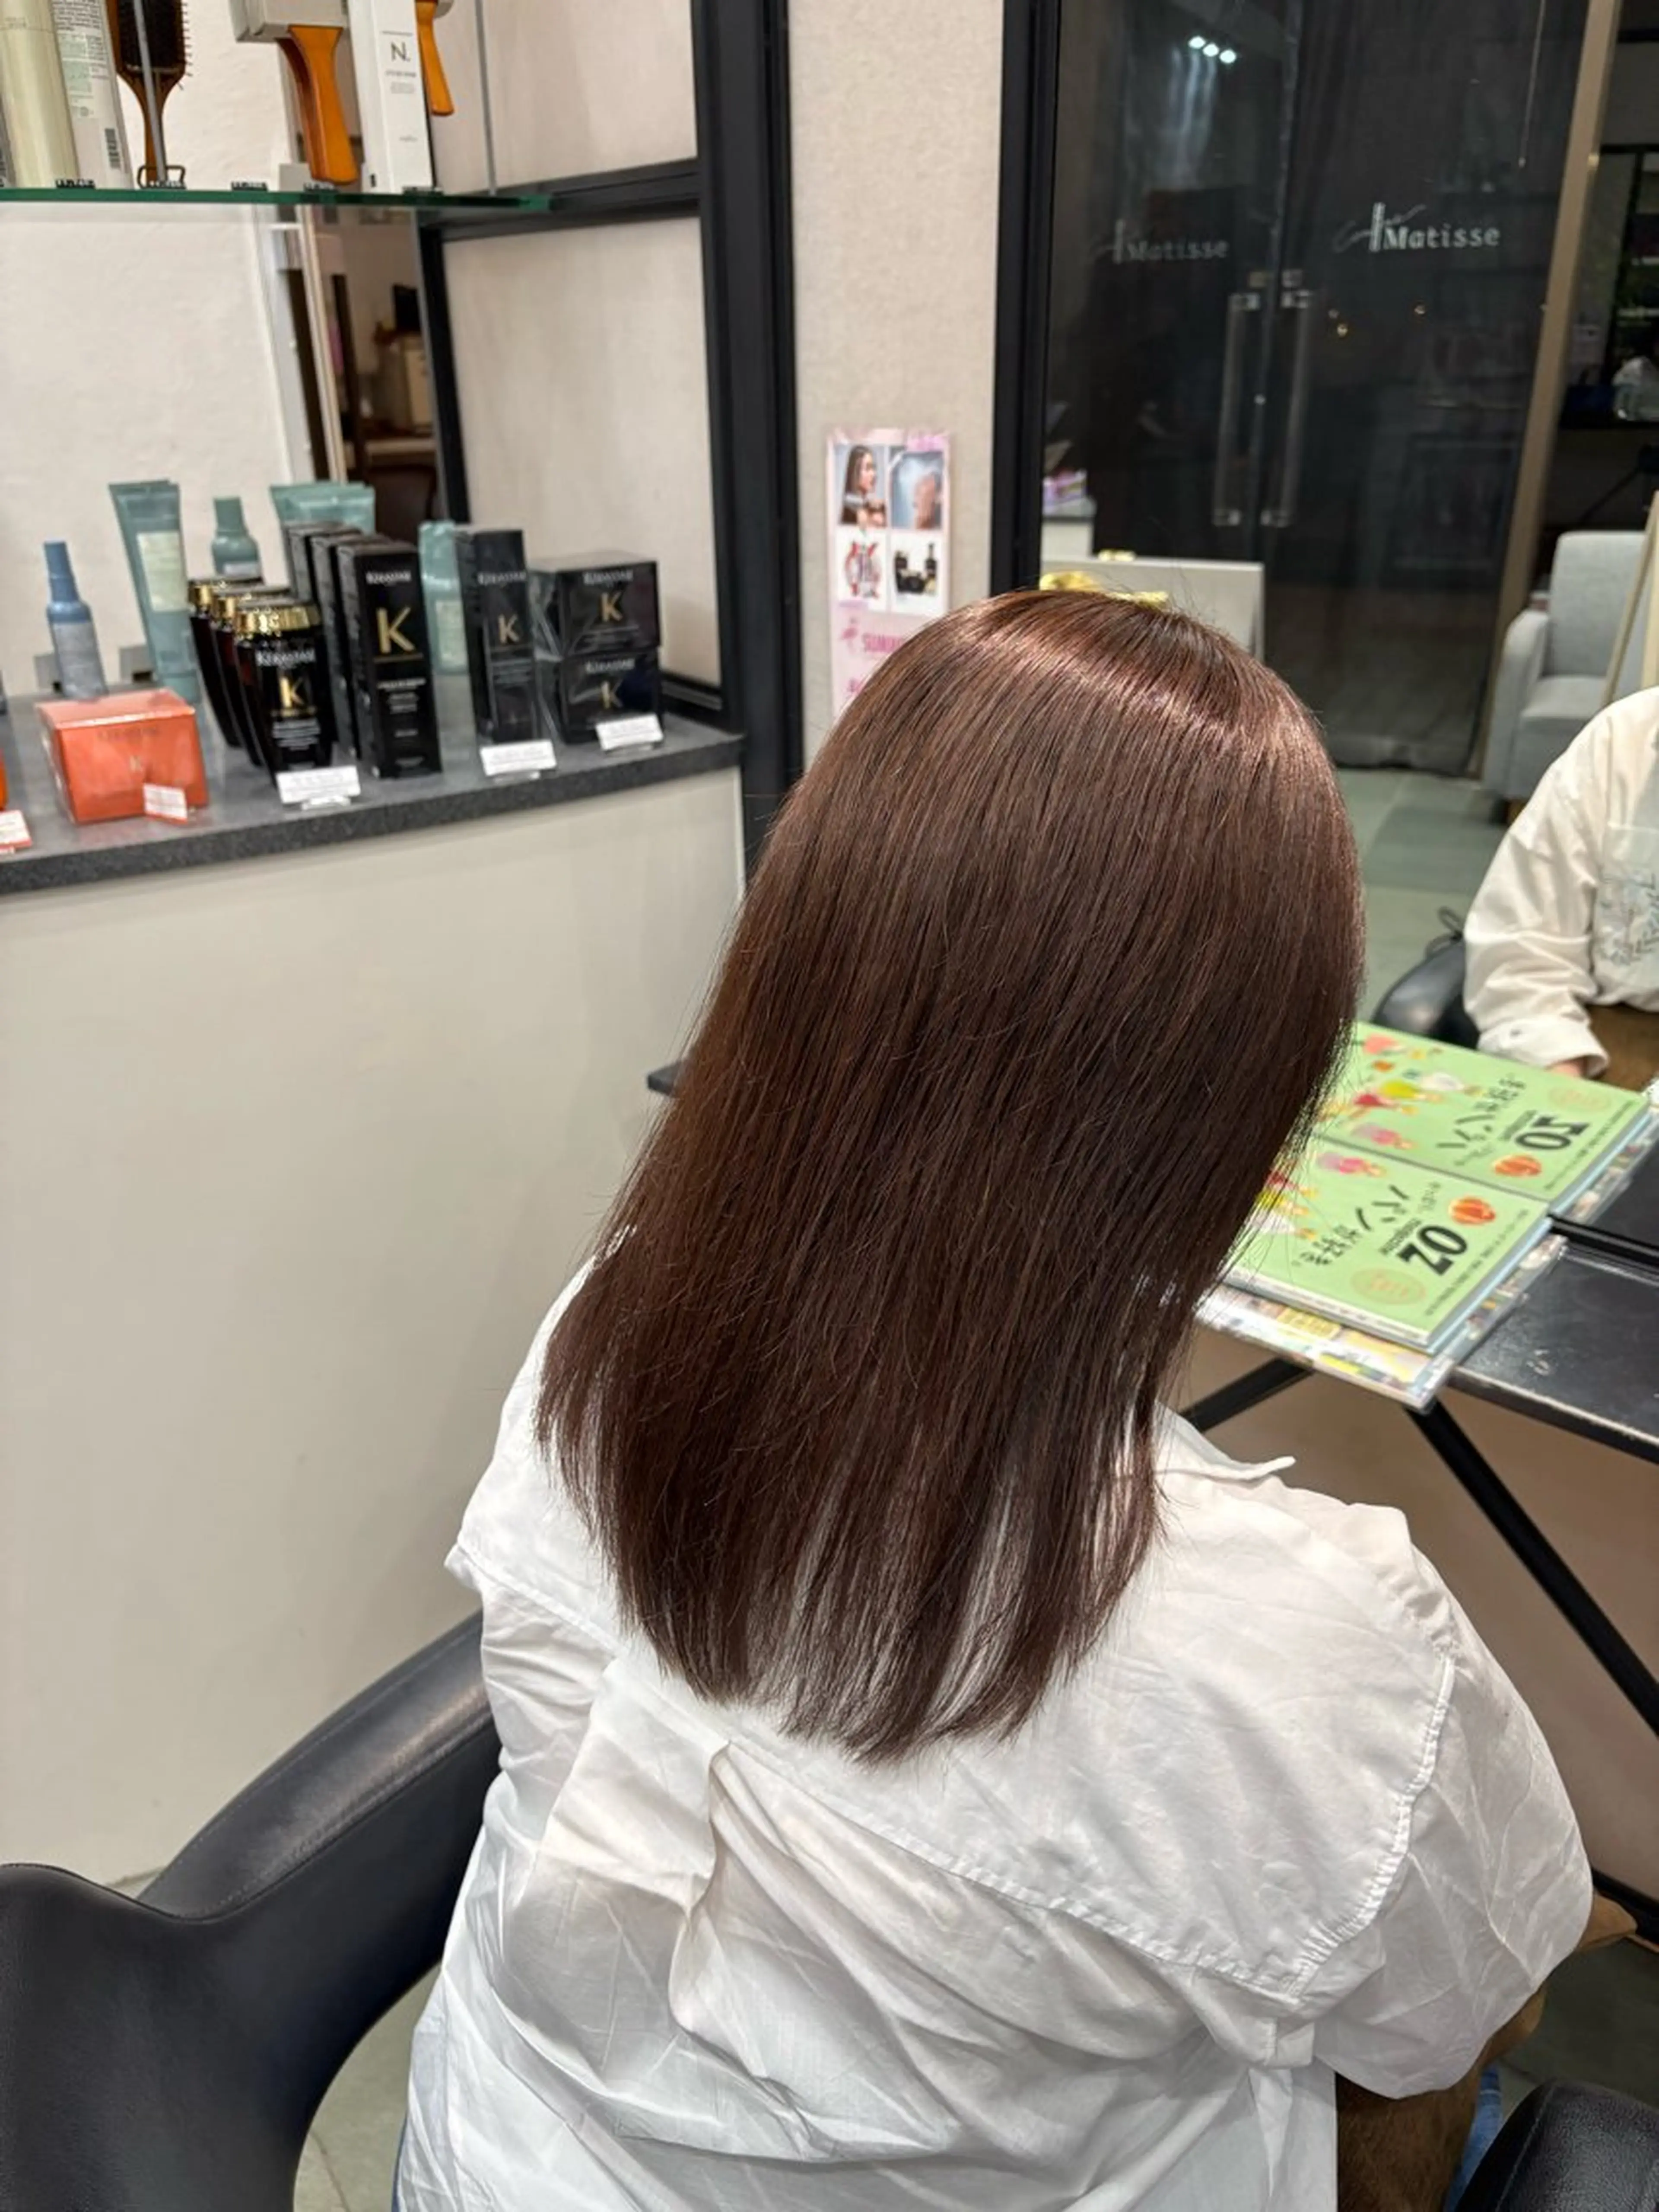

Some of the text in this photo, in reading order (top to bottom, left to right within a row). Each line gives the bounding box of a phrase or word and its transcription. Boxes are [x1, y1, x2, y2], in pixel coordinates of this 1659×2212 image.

[1384, 223, 1500, 250] Matisse
[600, 592, 623, 622] K
[375, 607, 415, 654] K
[498, 614, 519, 644] K
[280, 676, 304, 709] K
[601, 681, 623, 709] K
[1396, 1225, 1468, 1276] OZ
